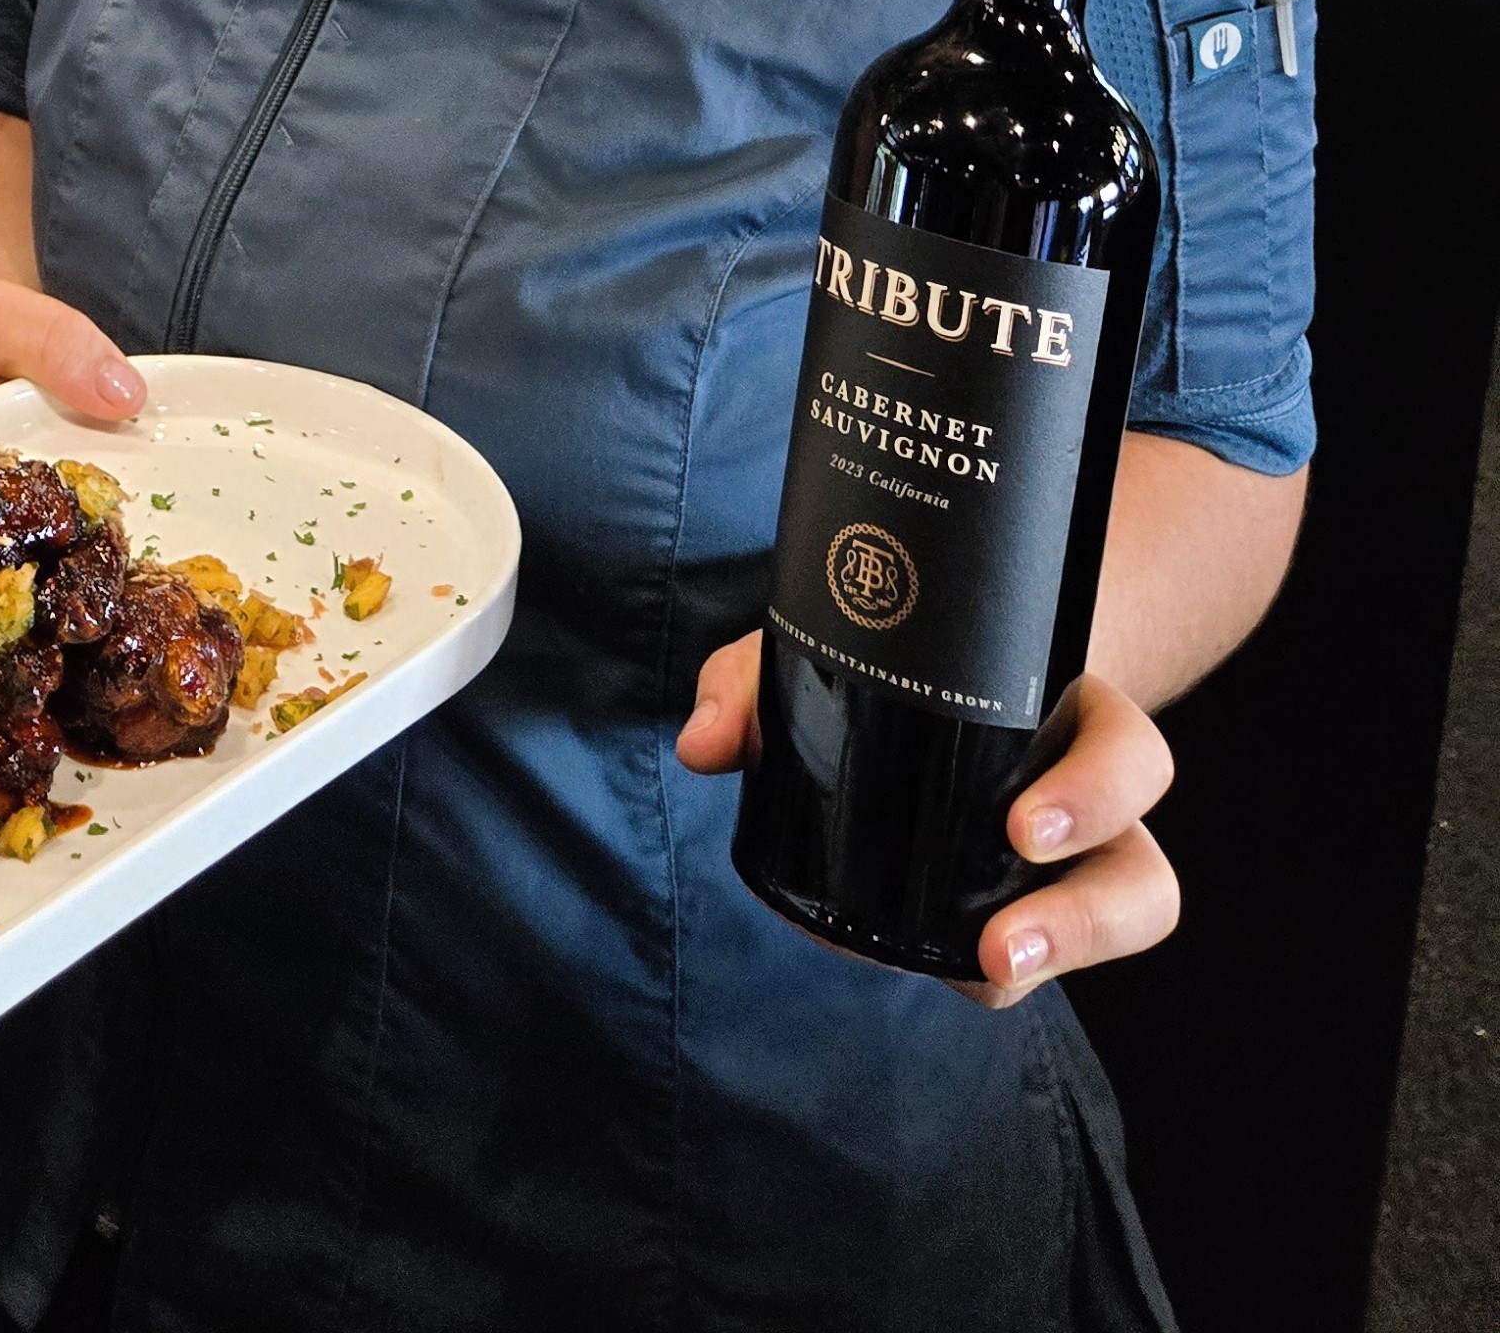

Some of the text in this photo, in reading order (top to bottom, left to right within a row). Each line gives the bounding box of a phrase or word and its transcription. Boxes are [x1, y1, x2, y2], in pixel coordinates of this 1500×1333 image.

[815, 235, 1074, 367] TRIBUTE
[810, 398, 1000, 484] SAUVIGNON
[821, 371, 993, 448] CABERNET
[828, 453, 950, 510] 2023 California
[768, 605, 816, 648] CERTIFIED
[820, 643, 933, 697] SUSTAINABLY
[941, 689, 1004, 712] GROWN
